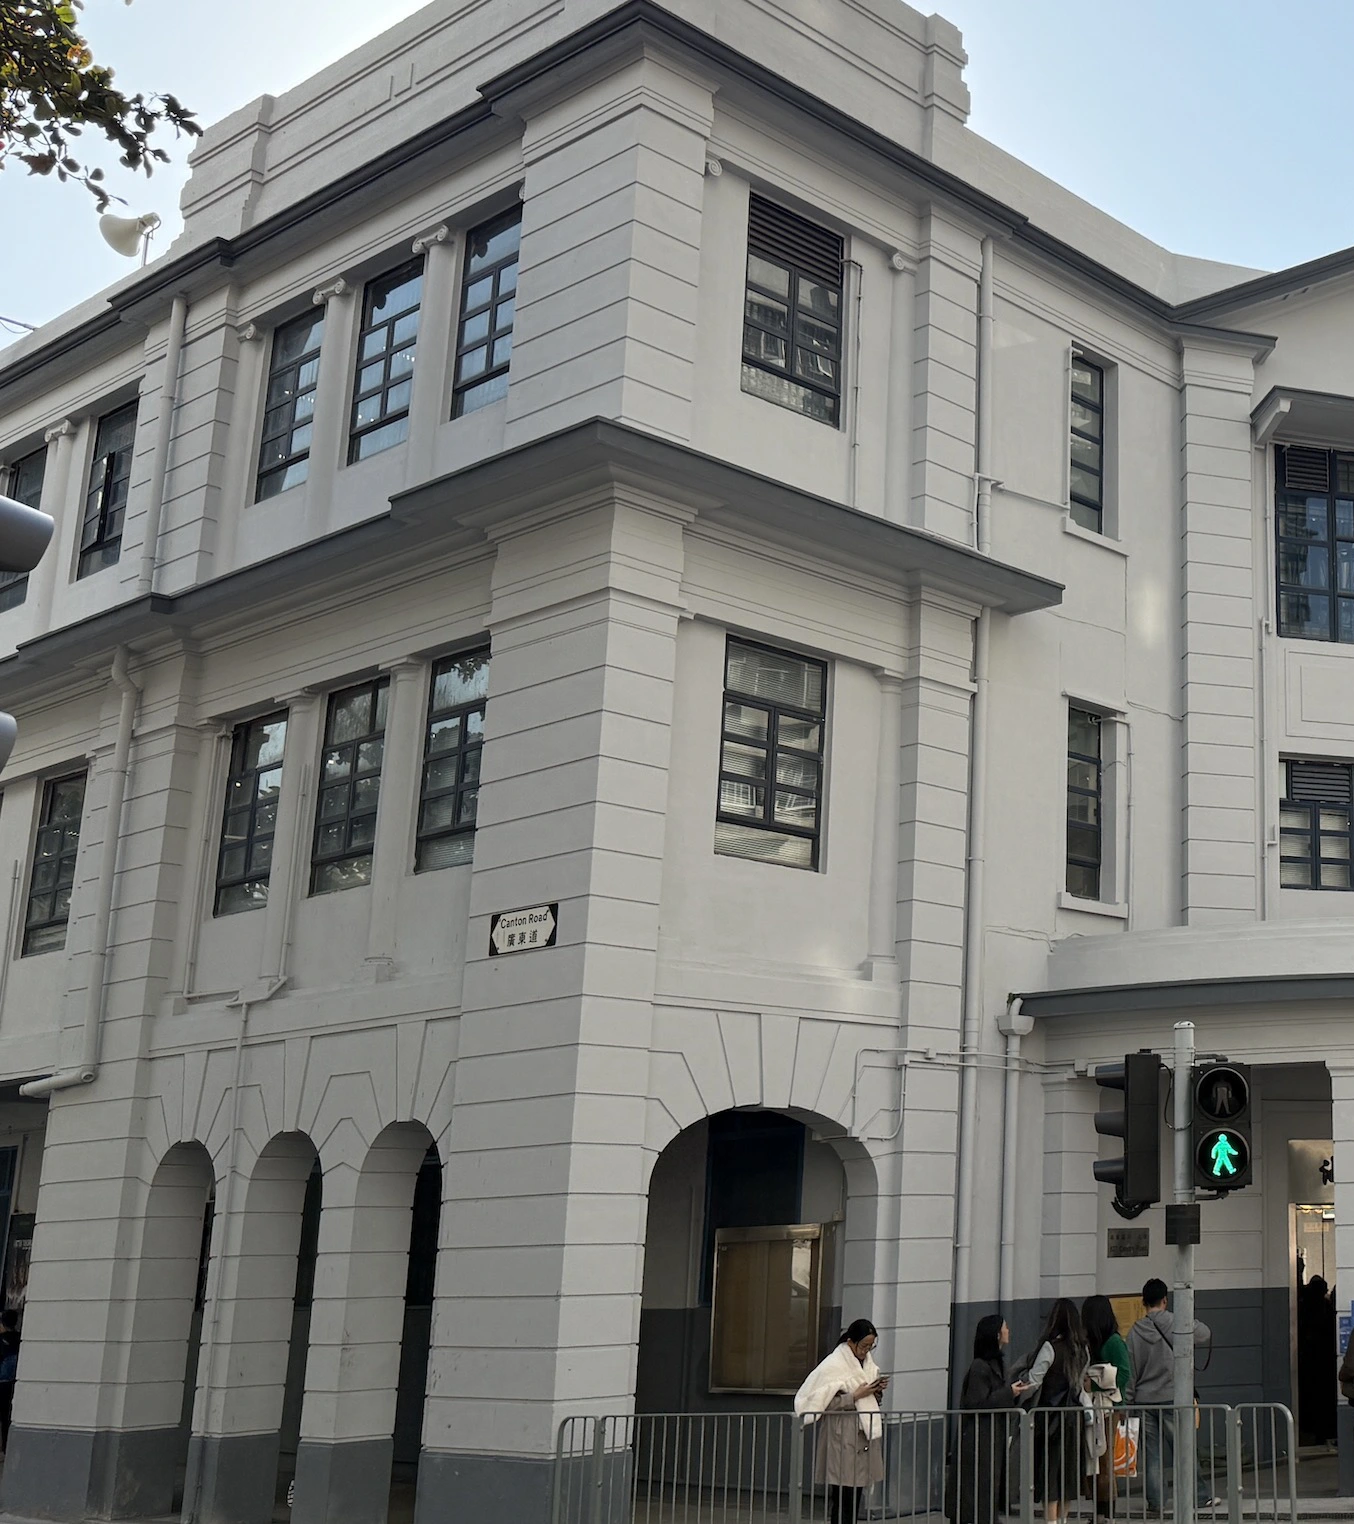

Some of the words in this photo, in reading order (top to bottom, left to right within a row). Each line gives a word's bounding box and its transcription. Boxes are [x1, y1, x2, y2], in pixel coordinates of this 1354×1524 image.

[500, 916, 527, 929] Canton
[528, 911, 548, 924] Road
[507, 929, 538, 947] 廣東道
